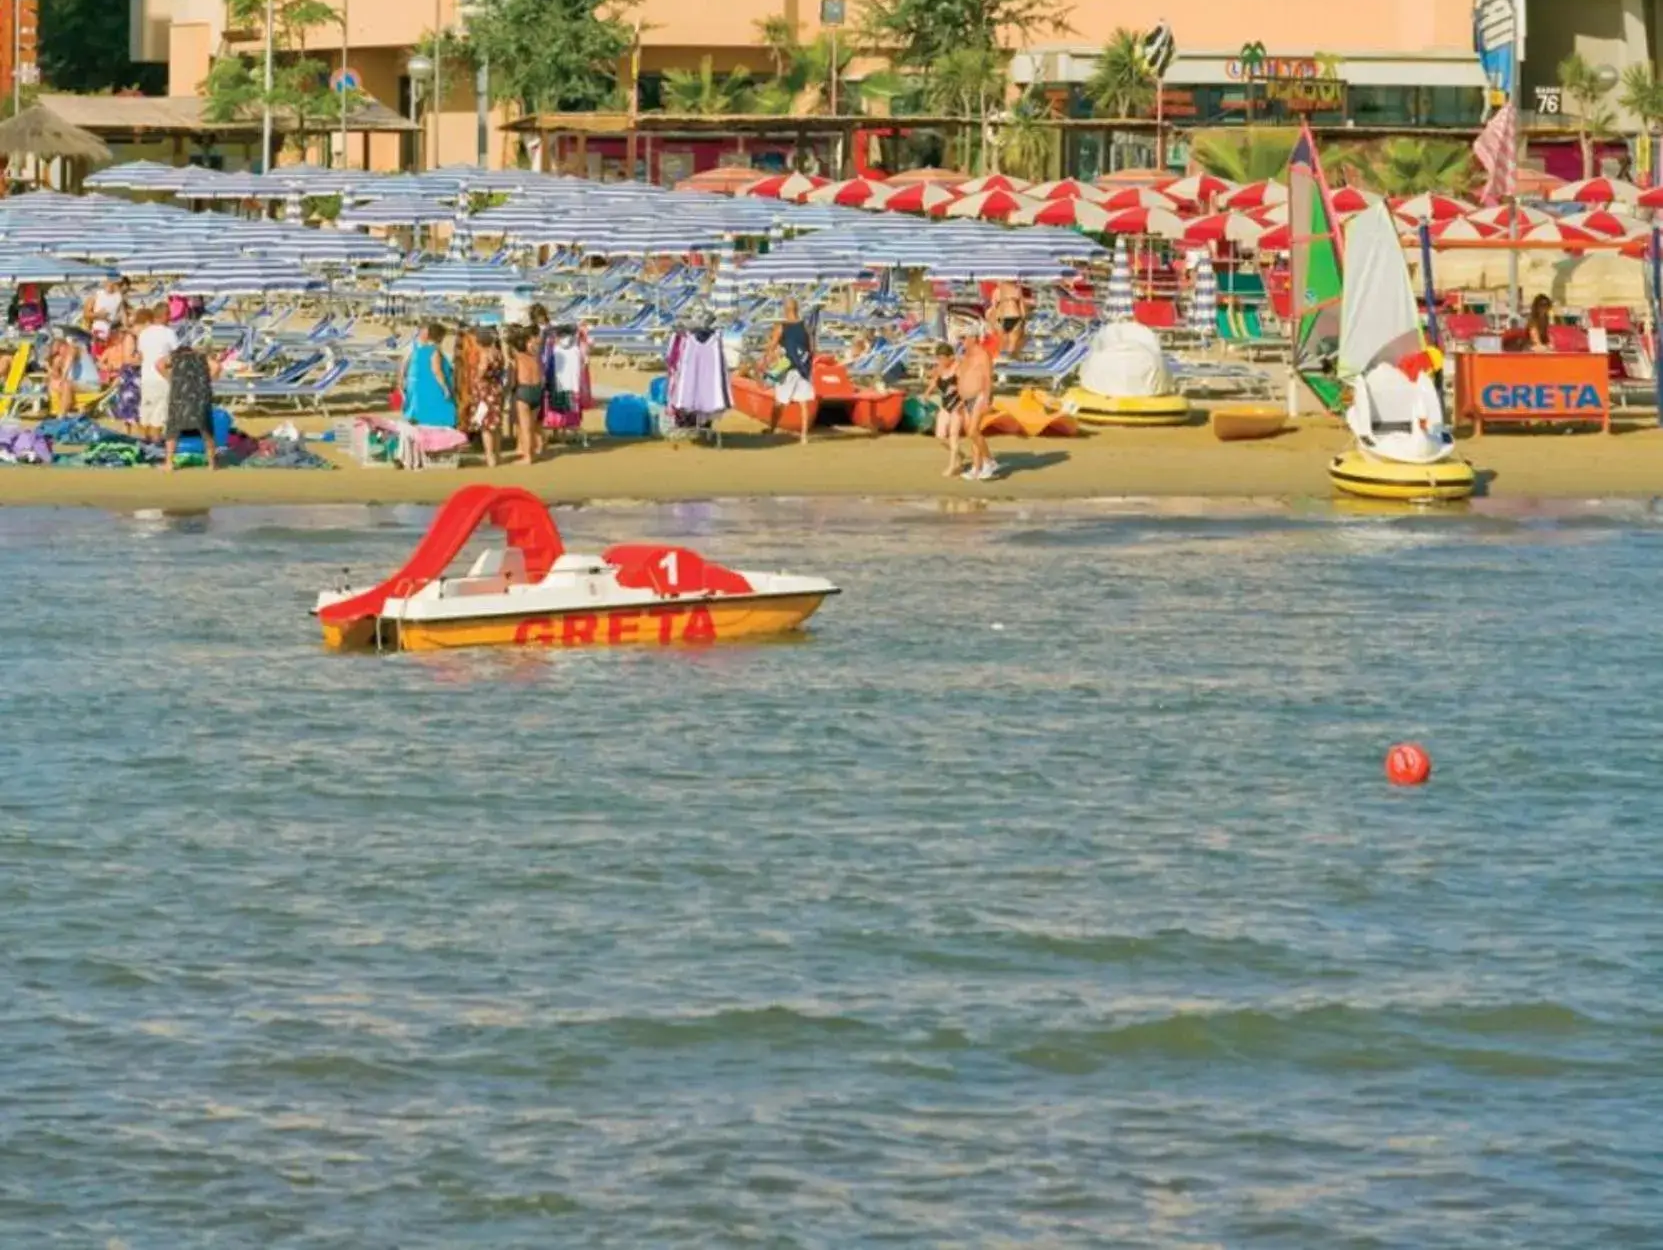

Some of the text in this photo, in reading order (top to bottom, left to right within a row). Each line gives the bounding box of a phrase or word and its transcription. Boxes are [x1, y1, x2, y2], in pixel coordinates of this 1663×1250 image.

[1537, 94, 1559, 114] 76
[1482, 382, 1602, 409] GRETA
[659, 551, 677, 586] 1
[514, 607, 716, 646] GRETA
